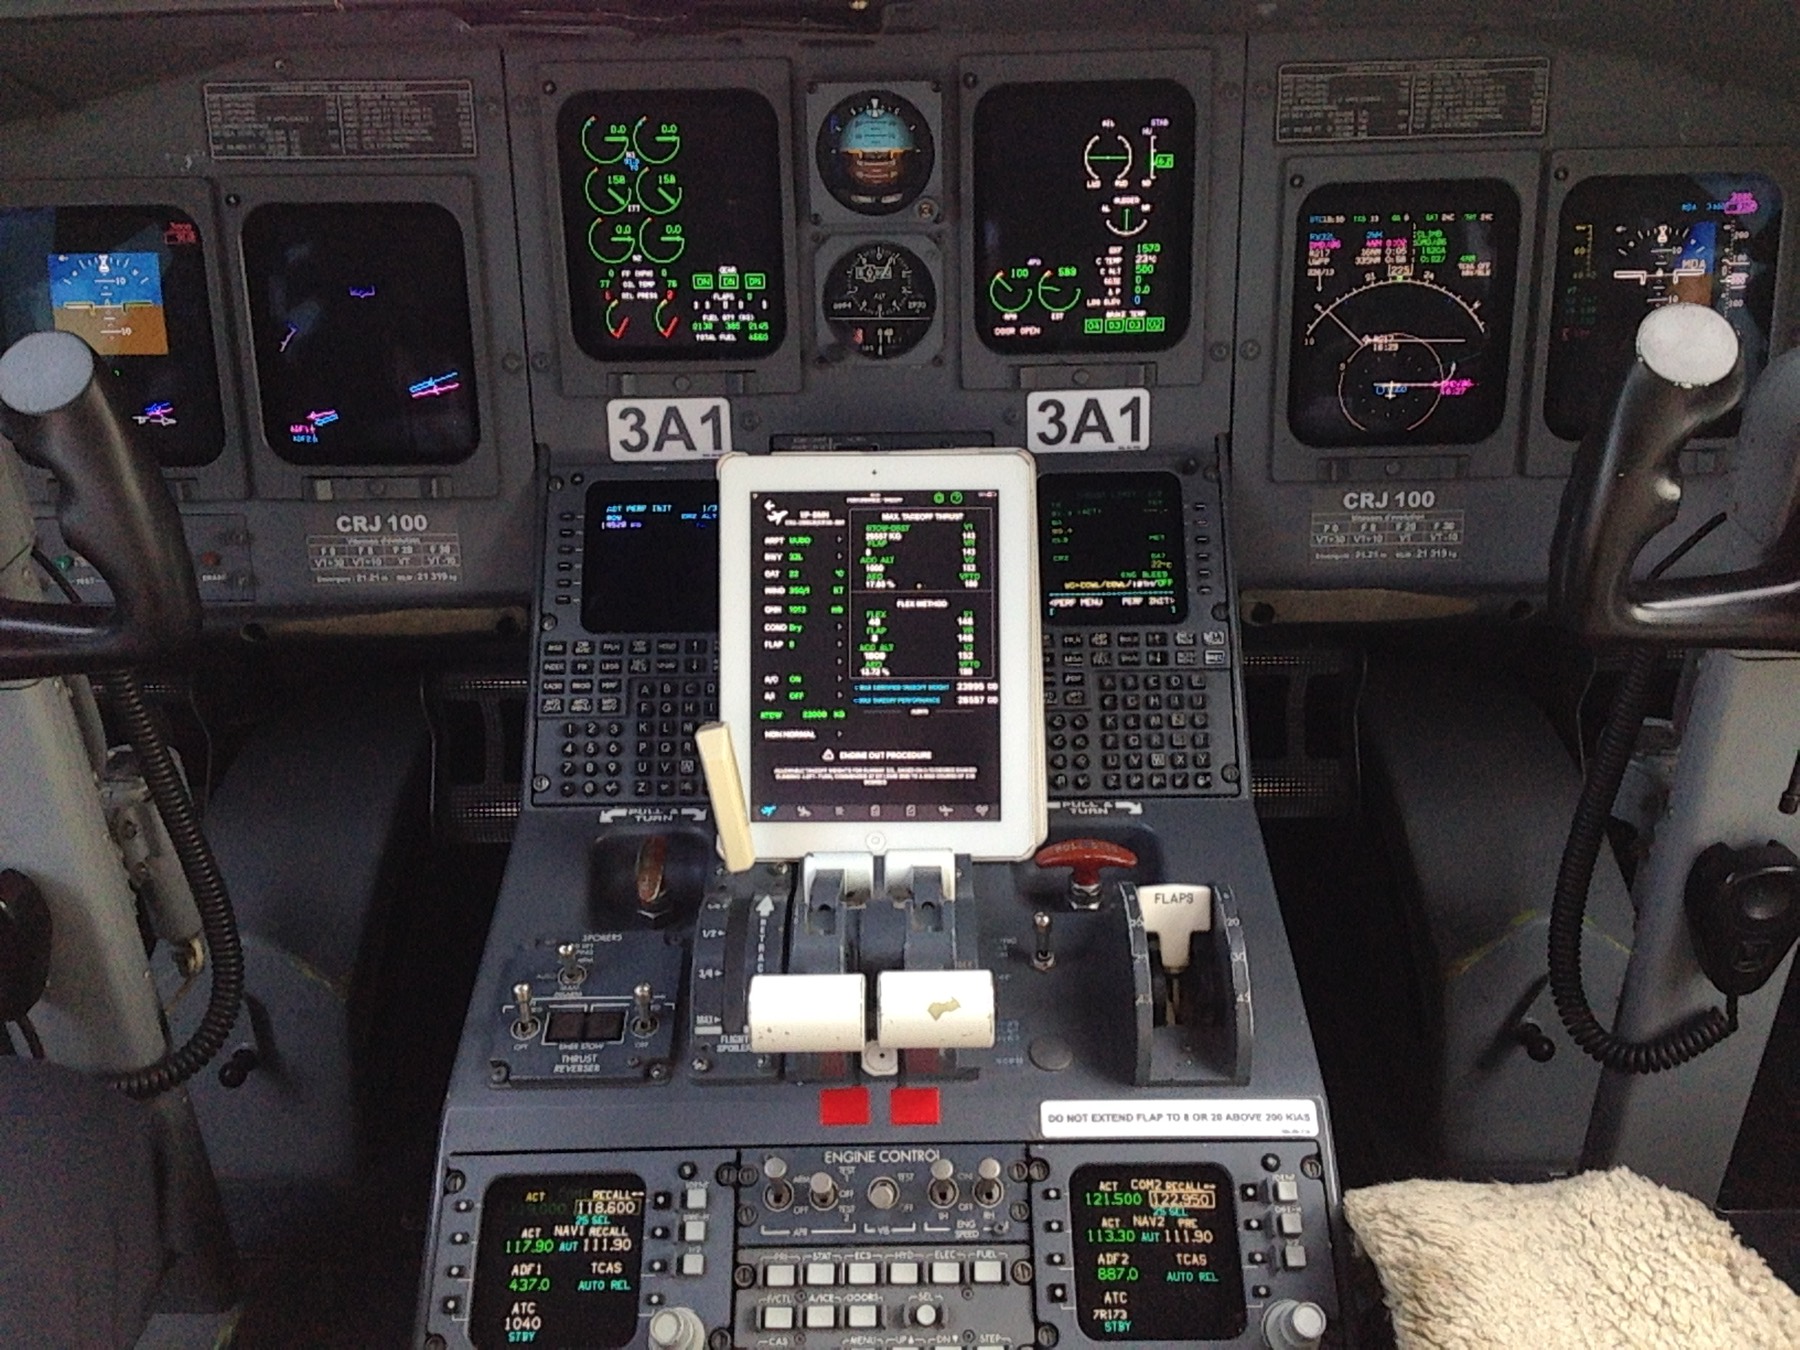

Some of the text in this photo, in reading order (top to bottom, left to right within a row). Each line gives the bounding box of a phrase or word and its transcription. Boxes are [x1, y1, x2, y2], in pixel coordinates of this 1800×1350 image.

[661, 124, 677, 133] 0.0
[616, 225, 631, 234] 0.0
[666, 225, 682, 234] 0.0
[1036, 396, 1144, 446] 3A1
[619, 406, 725, 453] 3A1
[1343, 491, 1435, 509] CRJ 100
[336, 514, 427, 532] CRJ 100
[1154, 893, 1194, 904] FLAPS
[1048, 1114, 1064, 1122] DO
[1067, 1114, 1088, 1122] NOT
[1092, 1113, 1134, 1122] EXTEND
[1137, 1113, 1163, 1122] FLAP
[1166, 1113, 1180, 1121] TO
[1193, 1113, 1207, 1121] OR
[1226, 1113, 1261, 1121] ABOVE
[825, 1151, 876, 1164] ENGINE
[1099, 1179, 1203, 1190] ACT COM2 RECALL
[526, 1192, 546, 1202] ACT
[593, 1190, 631, 1200] RECALL
[1085, 1192, 1142, 1206] 121.500
[577, 1201, 636, 1214] 118.600
[592, 1216, 610, 1225] SEL
[957, 1220, 976, 1229] ENG
[1101, 1218, 1121, 1227] ACT
[1133, 1215, 1165, 1227] NAV2
[521, 1227, 542, 1238] ACT
[589, 1226, 628, 1237] RECALL
[1087, 1230, 1214, 1243] 113.30 AUT 111.90
[505, 1238, 632, 1254] 117.90 AUT 111.90
[813, 1252, 832, 1260] STAT
[935, 1251, 957, 1259] ELEC
[976, 1250, 997, 1259] FUEL
[1097, 1253, 1130, 1265] ADF2
[1176, 1254, 1207, 1266] TCAS
[591, 1262, 622, 1273] TCAS
[1098, 1268, 1139, 1281] 887.0
[1166, 1272, 1193, 1281] AUTO
[509, 1278, 550, 1292] 437.0
[577, 1279, 631, 1291] AUTO REL
[1104, 1292, 1128, 1304] ATC
[511, 1302, 535, 1314] ATC
[504, 1317, 541, 1331] 1040
[1104, 1322, 1132, 1332] STBY
[508, 1332, 536, 1342] STBY
[979, 1334, 1001, 1343] STEP
